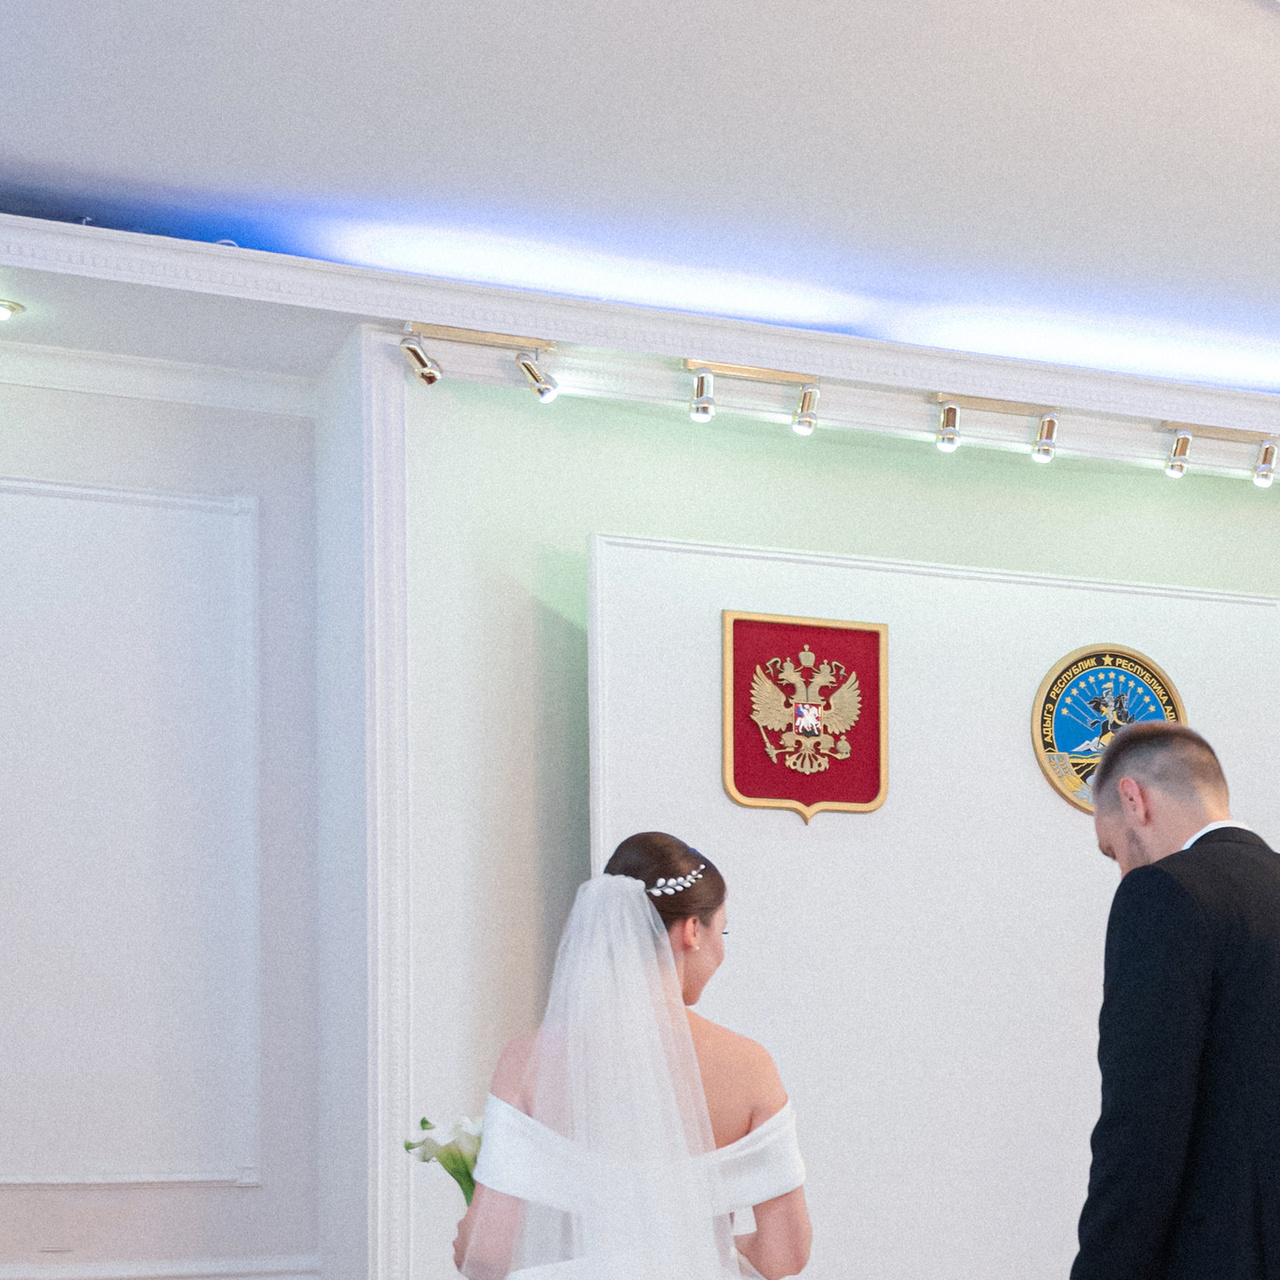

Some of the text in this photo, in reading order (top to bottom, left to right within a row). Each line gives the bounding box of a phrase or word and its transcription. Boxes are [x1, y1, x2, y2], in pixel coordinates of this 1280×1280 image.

[1043, 657, 1097, 743] АДЫГЭ РЕСПУБЛИК
[1116, 658, 1168, 704] РЕСПУБЛИКА
